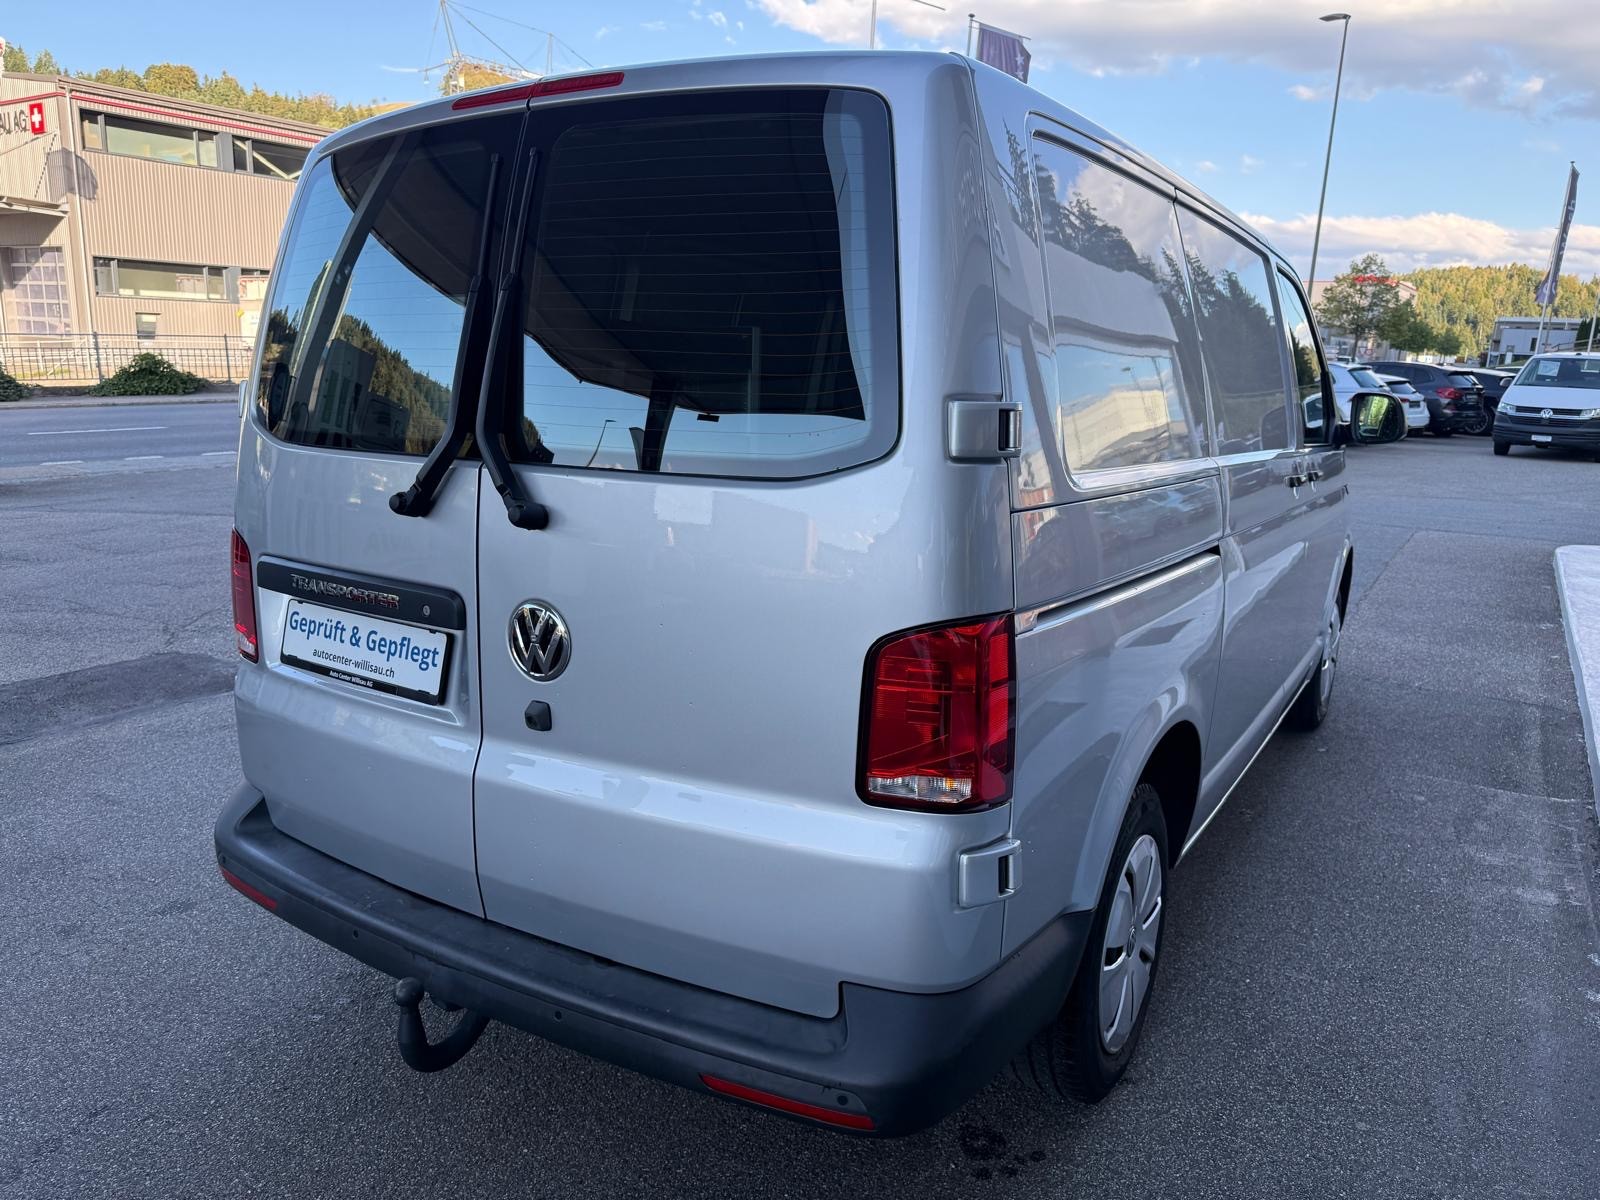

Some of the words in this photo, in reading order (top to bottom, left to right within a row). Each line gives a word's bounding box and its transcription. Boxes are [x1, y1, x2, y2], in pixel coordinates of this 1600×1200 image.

[13, 109, 27, 130] AG
[290, 573, 400, 609] TRANSPORTER
[289, 610, 347, 643] Geprüft
[349, 626, 361, 648] &
[366, 630, 439, 672] Gepflegt
[312, 647, 395, 679] autocenter-willisau.ch
